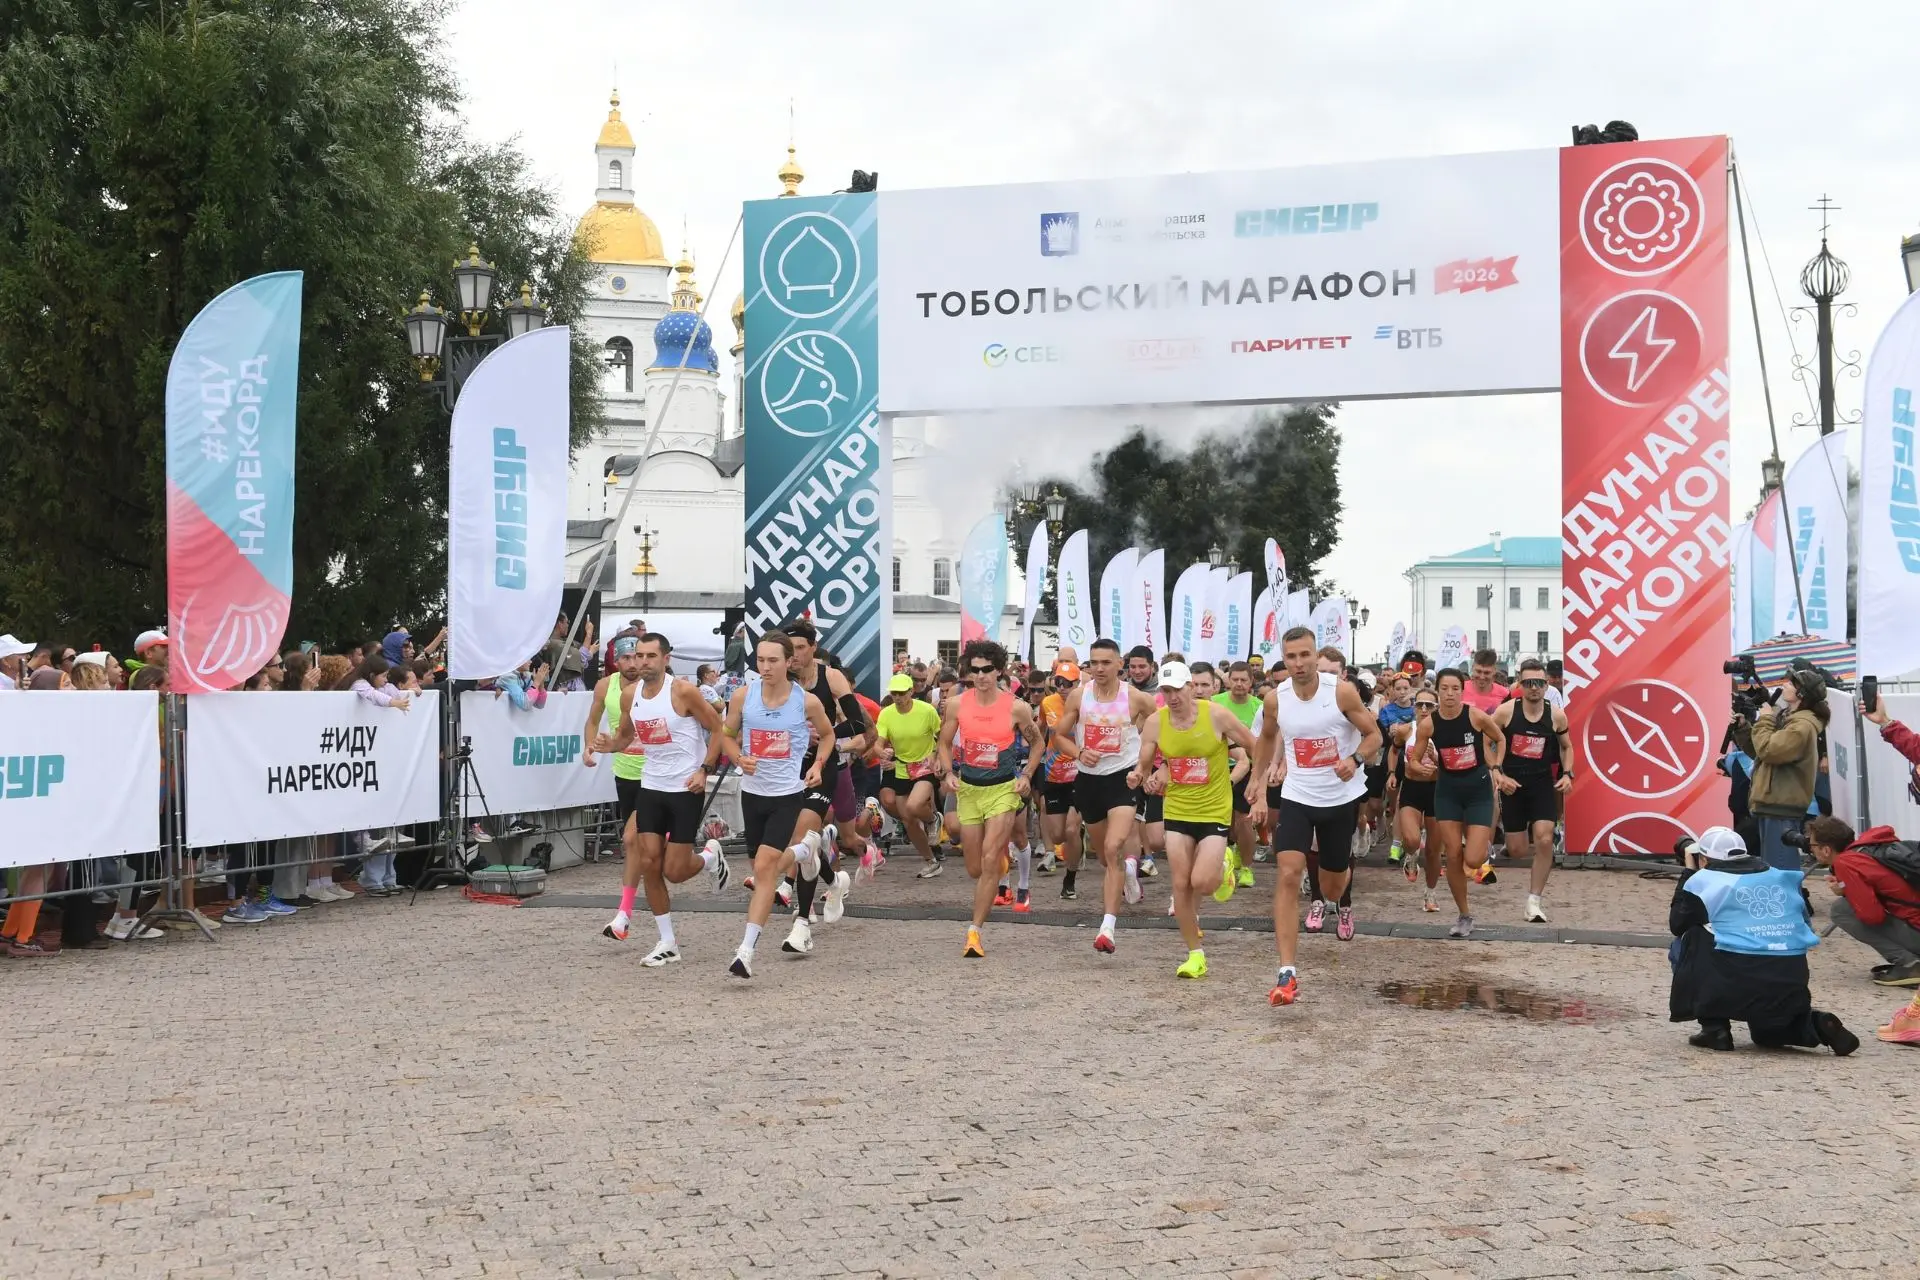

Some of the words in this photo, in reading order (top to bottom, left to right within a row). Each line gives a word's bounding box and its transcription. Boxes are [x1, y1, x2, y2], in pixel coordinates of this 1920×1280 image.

[1234, 202, 1379, 238] СИБУР
[916, 275, 1189, 318] ТОБОЛЬСКИЙ
[1202, 268, 1416, 307] МАРАФОН
[1452, 266, 1499, 284] 2026
[1231, 335, 1352, 353] ПАРИТЕТ
[1397, 327, 1443, 350] ВТБ
[200, 355, 237, 464] #ИДУ
[235, 354, 269, 555] НАРЕКОРД
[493, 427, 528, 590] СИБУР
[1067, 570, 1078, 619] СБЕР
[1112, 588, 1122, 650] ИБУР
[1183, 594, 1193, 652] СИБУР
[1227, 604, 1239, 655] СИБУР
[320, 725, 377, 758] #ИДУ
[513, 735, 580, 766] СИБУР
[0, 755, 64, 799] УР
[268, 761, 379, 794] НАРЕКОРД
[1745, 920, 1796, 933] ТОБОЛЬСКИЙ
